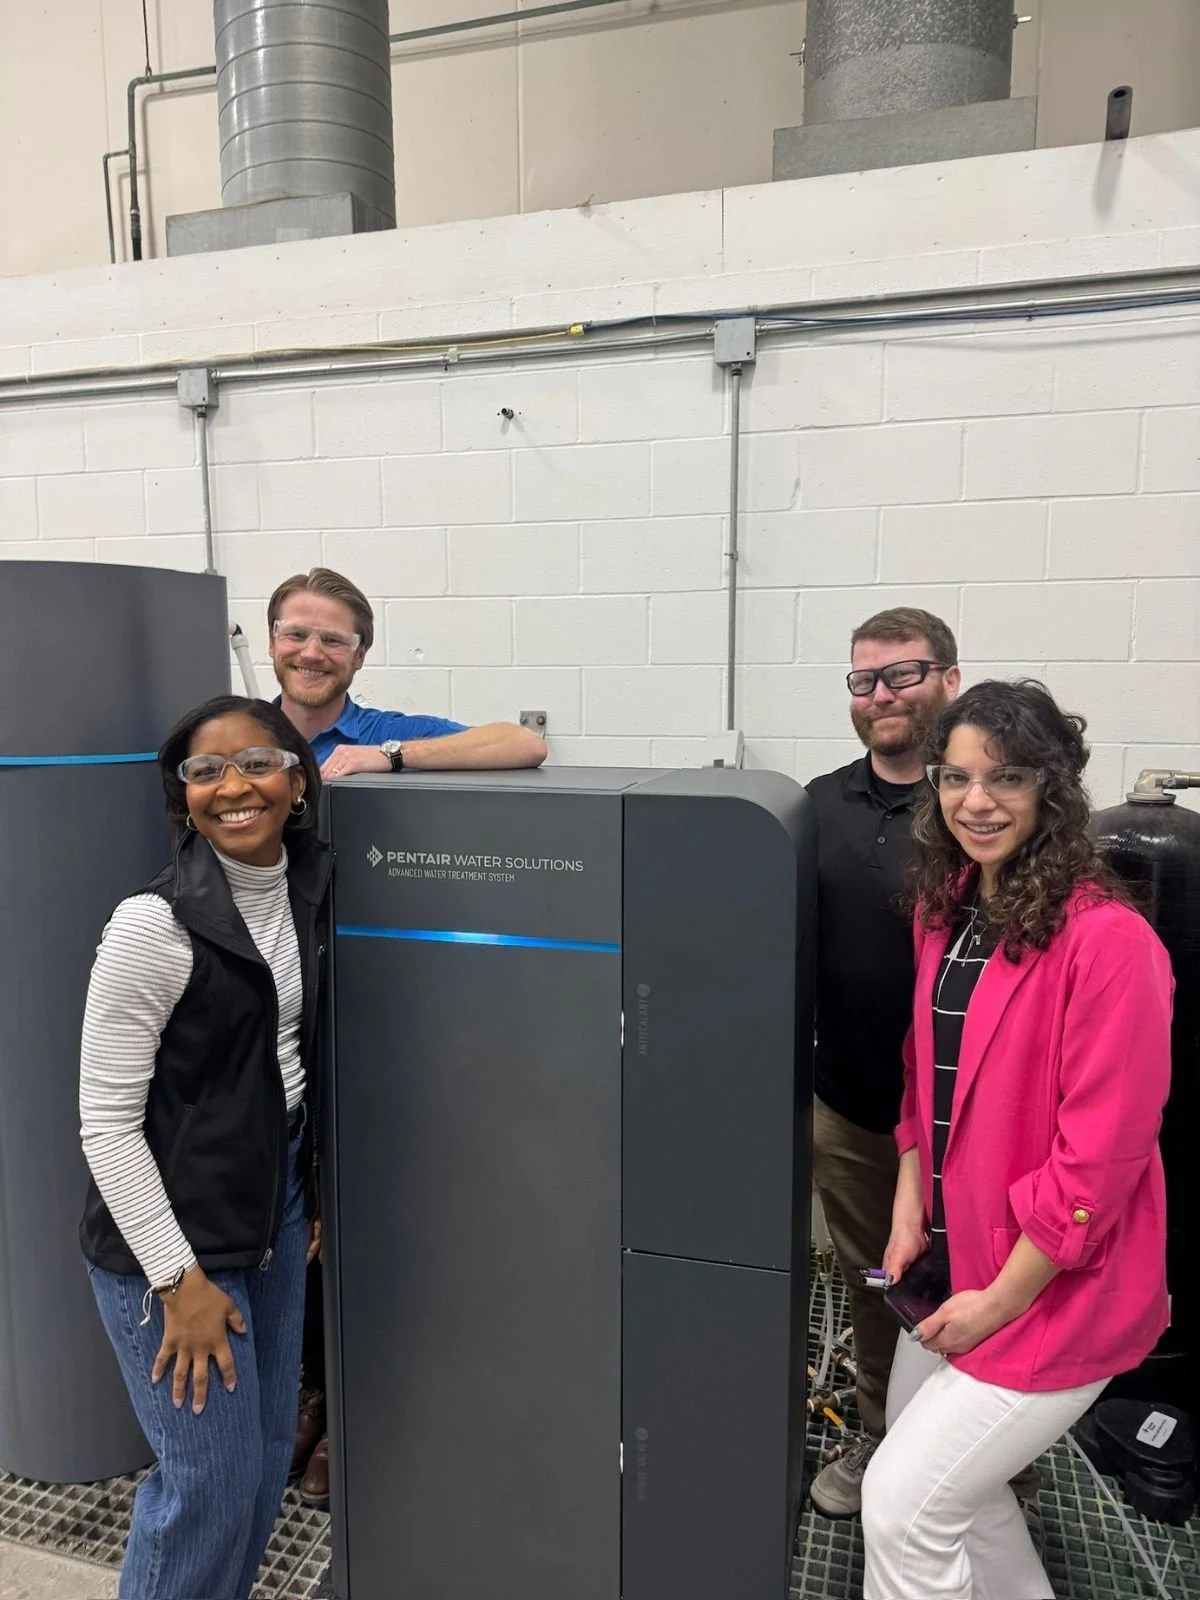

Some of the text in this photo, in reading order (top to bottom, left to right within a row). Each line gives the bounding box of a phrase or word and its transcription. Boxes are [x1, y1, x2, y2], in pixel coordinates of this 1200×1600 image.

[387, 851, 584, 872] PENTAIR WATER SOLUTIONS
[388, 867, 515, 883] ADVANCED WATER TREATMENT SYSTEM
